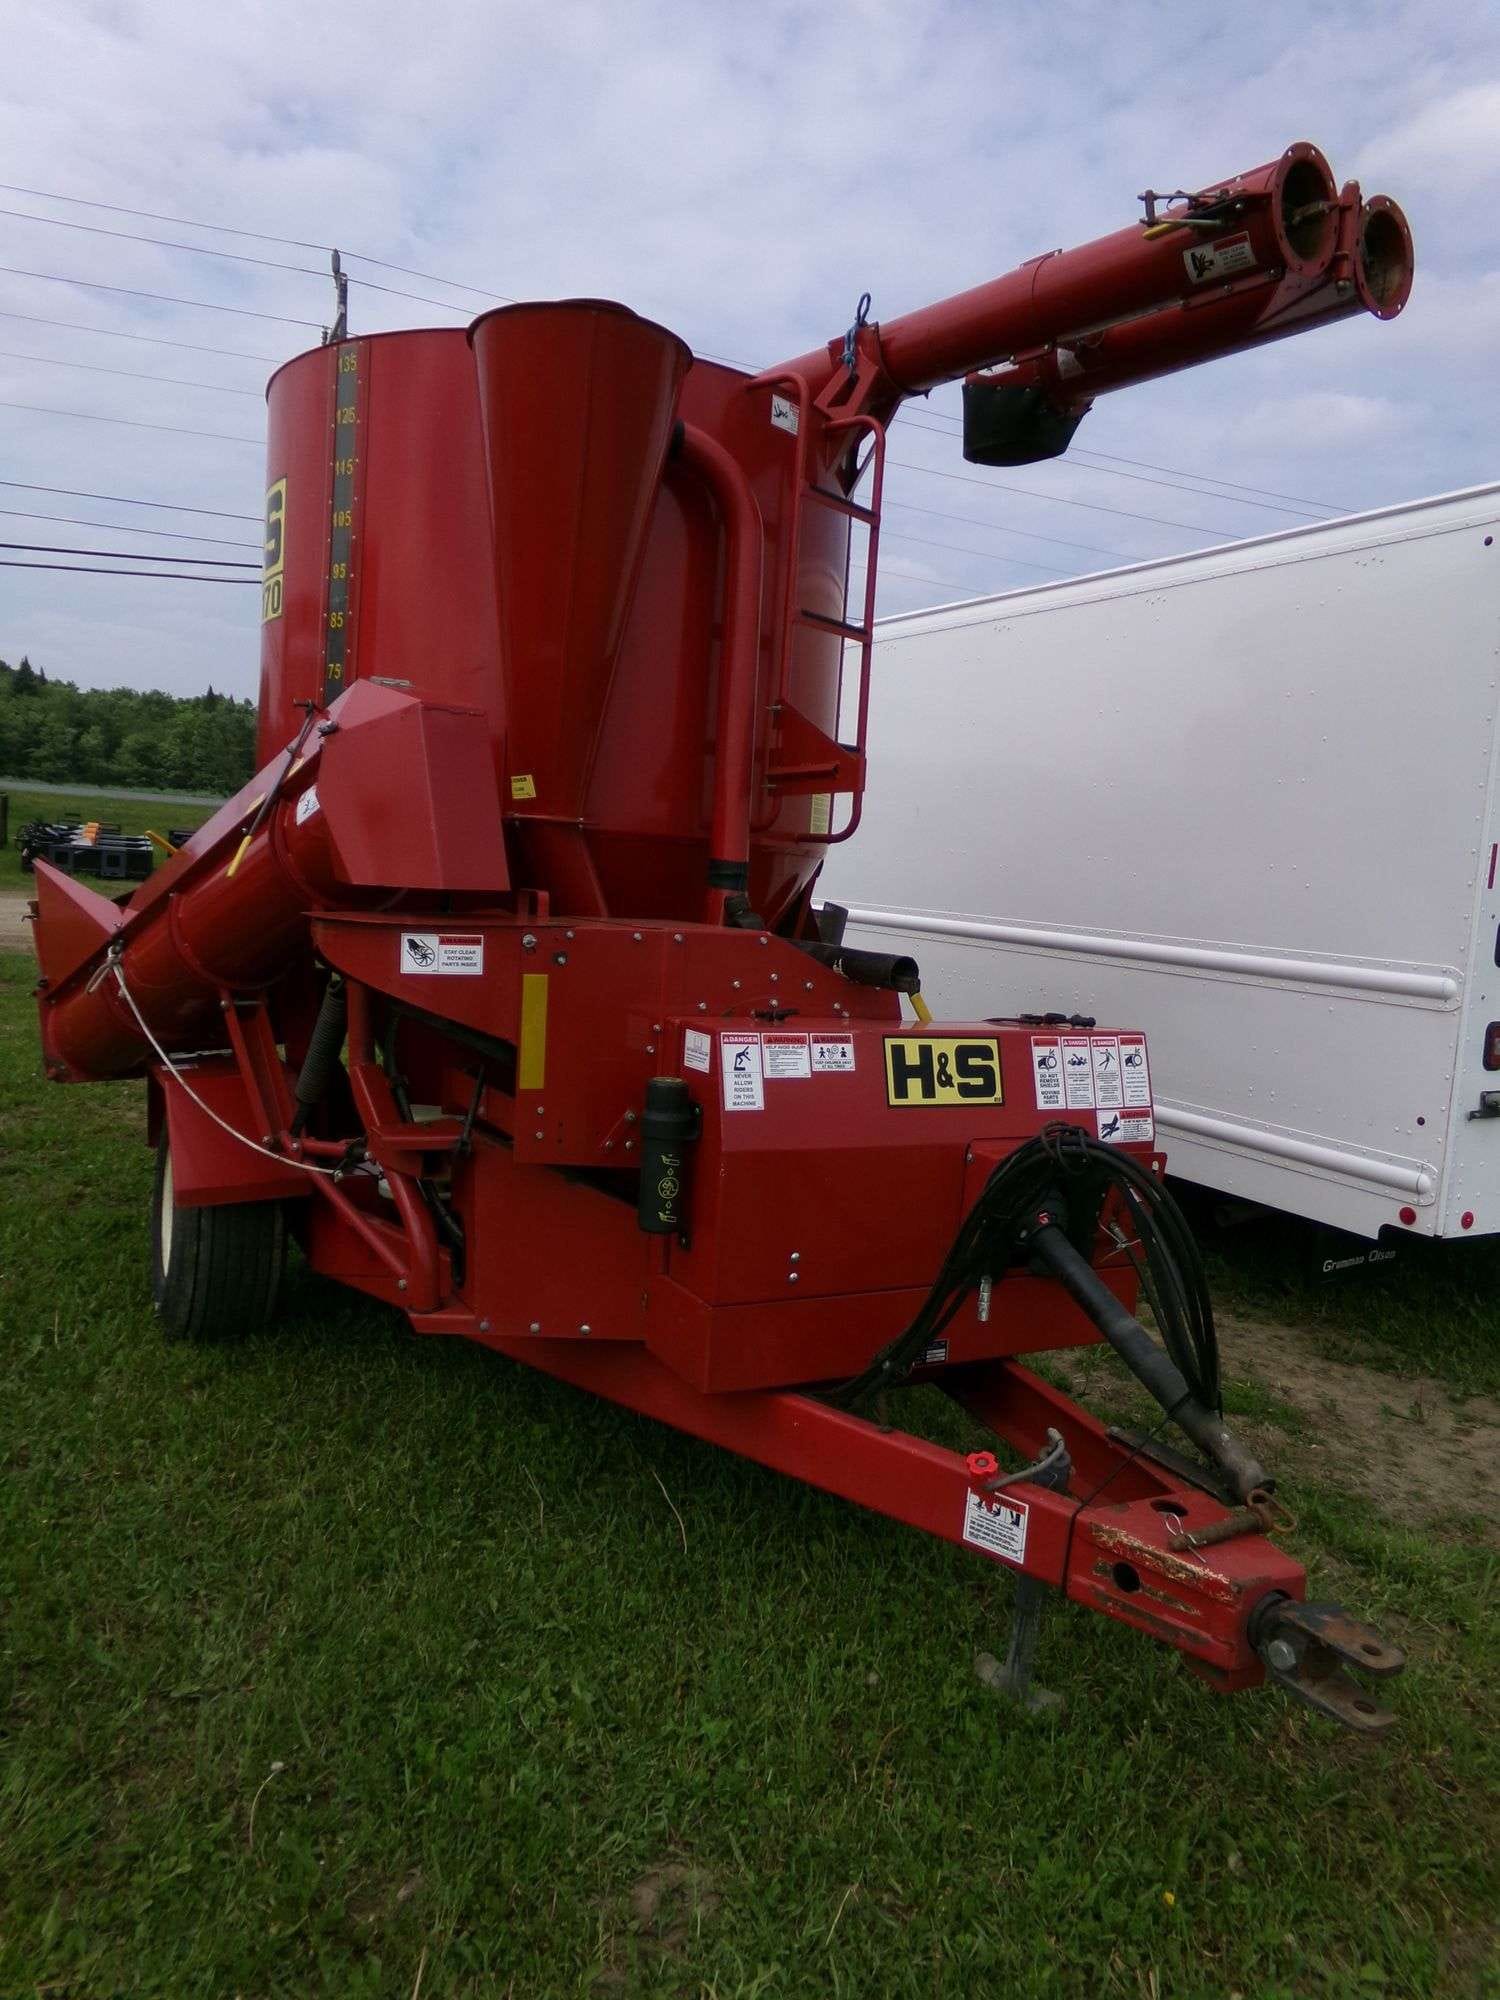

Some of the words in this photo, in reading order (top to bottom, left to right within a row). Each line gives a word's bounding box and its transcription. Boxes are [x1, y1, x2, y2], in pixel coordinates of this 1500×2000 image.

[336, 407, 356, 424] 125
[334, 458, 354, 476] 115
[332, 563, 346, 579] 95
[330, 612, 344, 628] 85
[328, 664, 342, 680] 75
[890, 1044, 997, 1099] H&S
